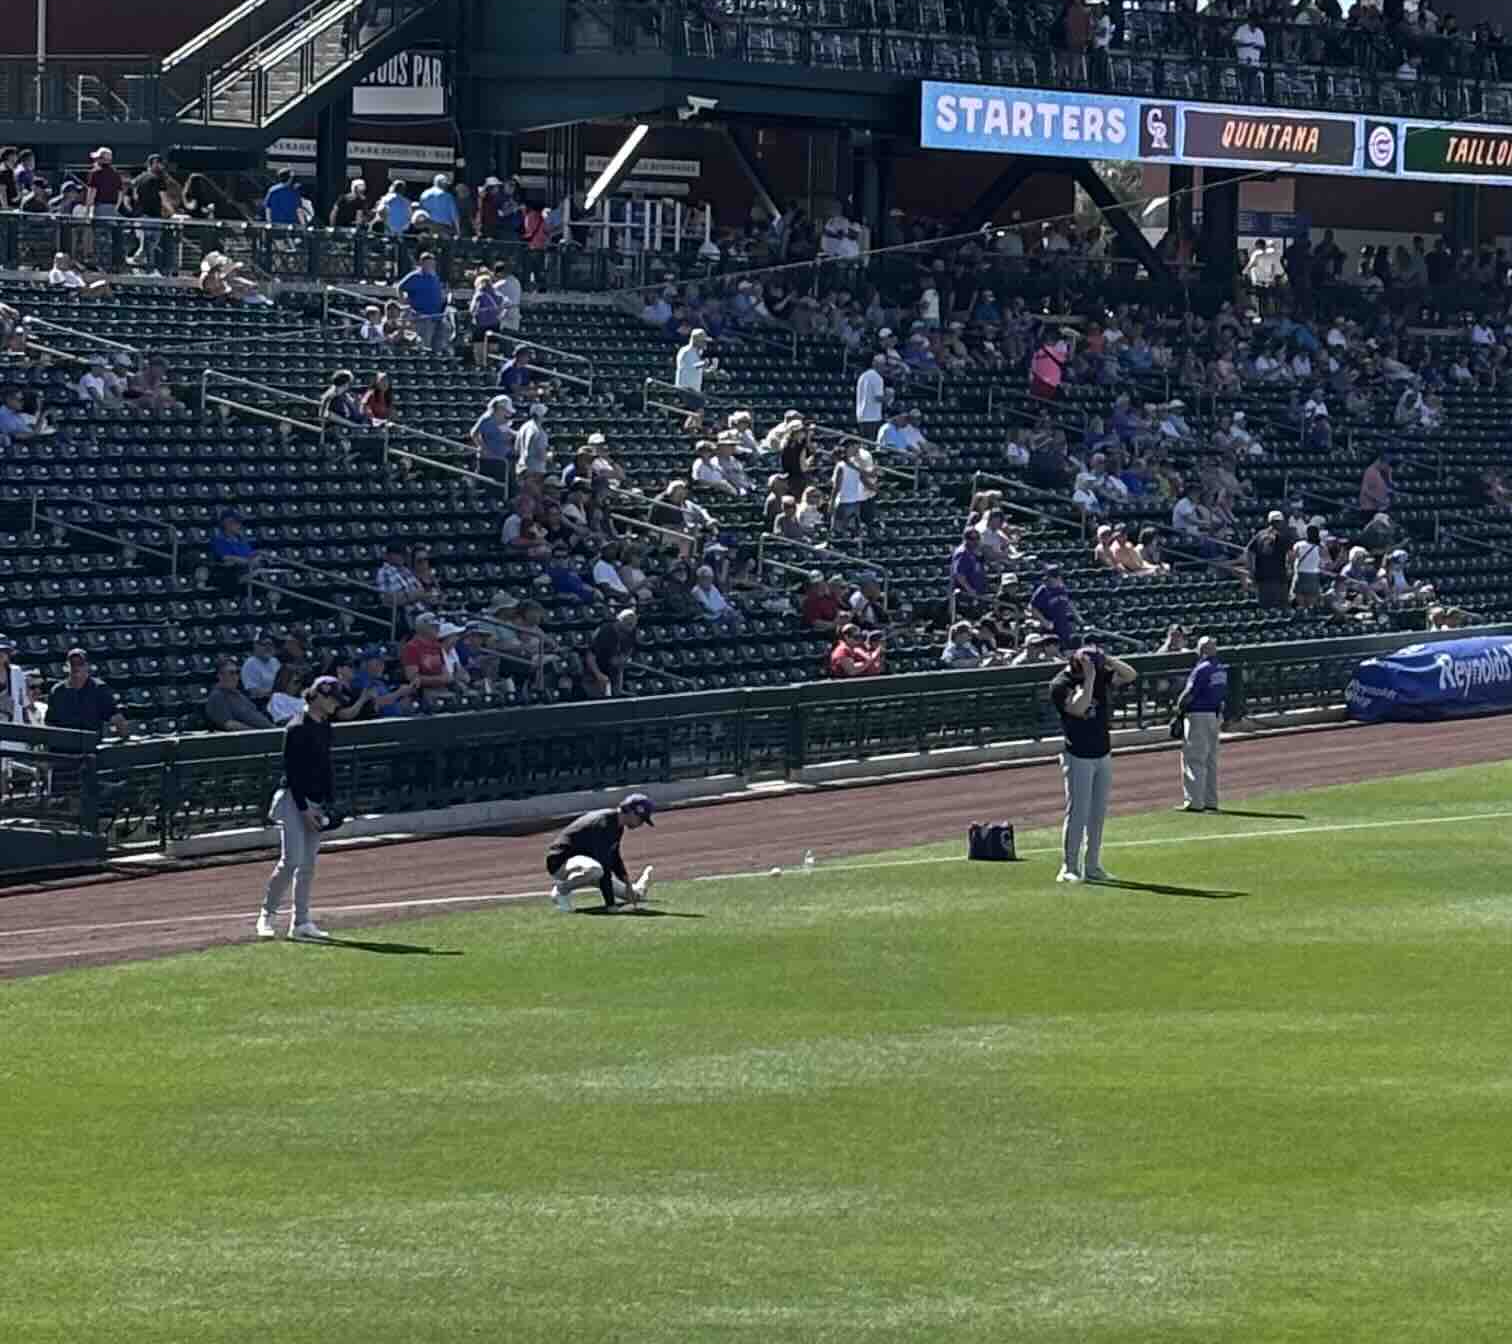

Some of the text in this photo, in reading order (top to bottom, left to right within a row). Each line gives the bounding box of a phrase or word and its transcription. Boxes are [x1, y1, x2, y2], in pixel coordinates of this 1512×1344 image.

[936, 95, 1126, 144] STARTERS
[1221, 120, 1320, 153] QUINTANA
[1436, 647, 1511, 698] Reynolds
